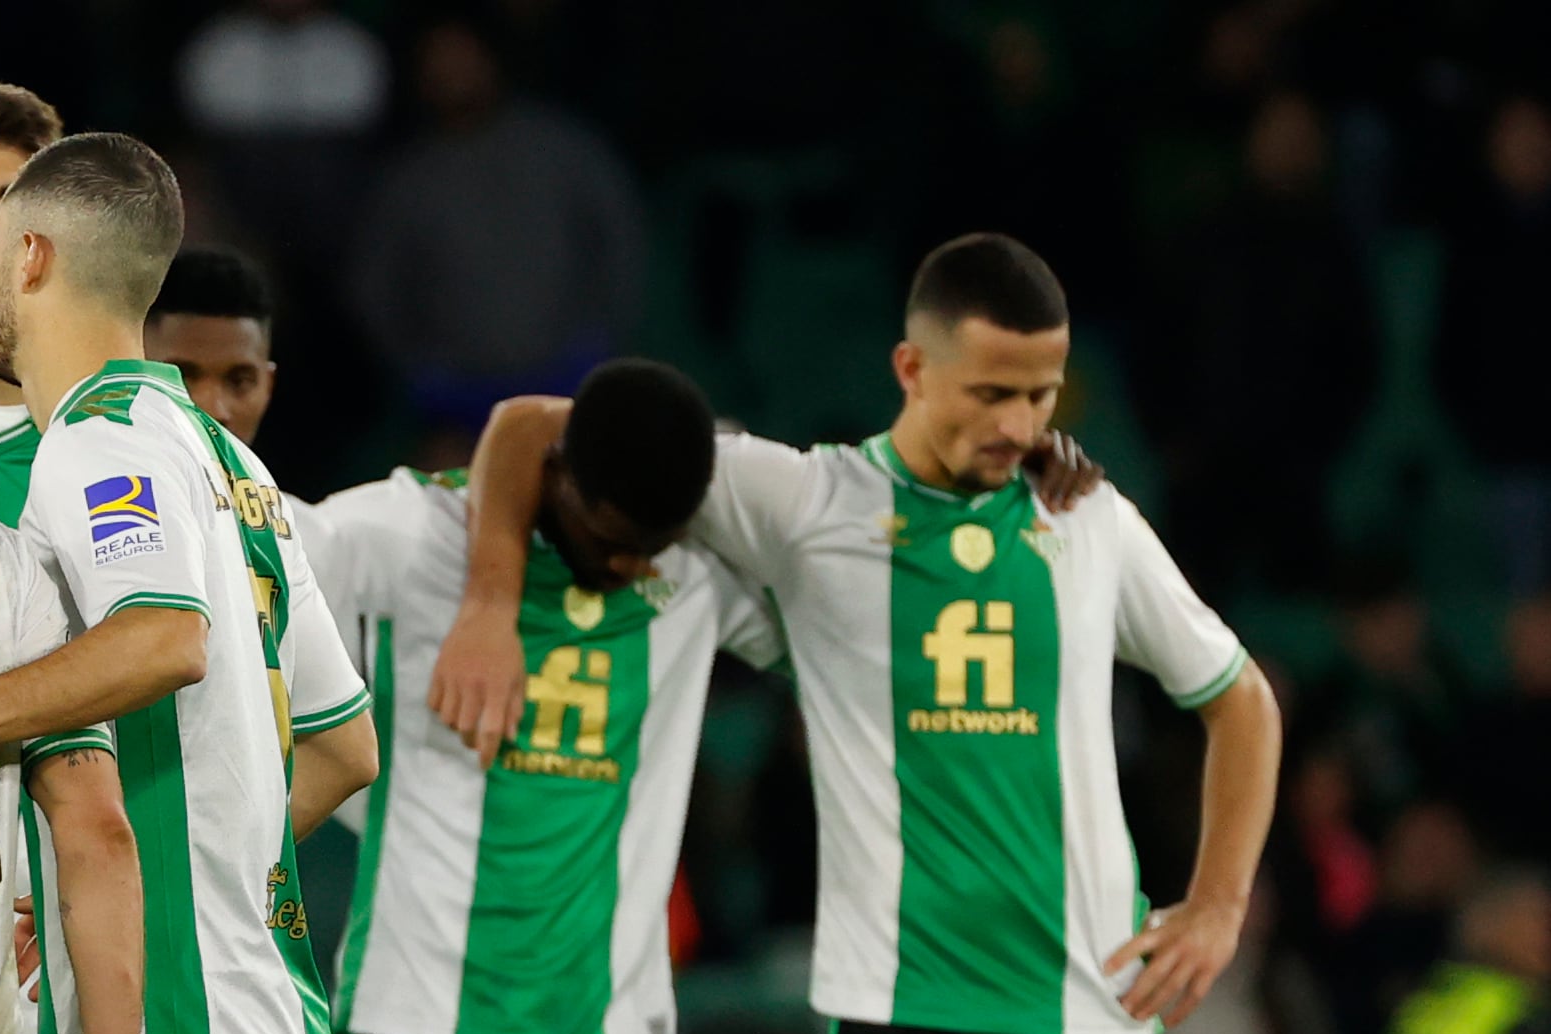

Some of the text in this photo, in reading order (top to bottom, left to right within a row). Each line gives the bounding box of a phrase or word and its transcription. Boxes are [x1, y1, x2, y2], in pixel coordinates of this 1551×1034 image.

[95, 532, 163, 558] REALE
[95, 544, 164, 566] SEGUROS
[907, 706, 1039, 735] network
